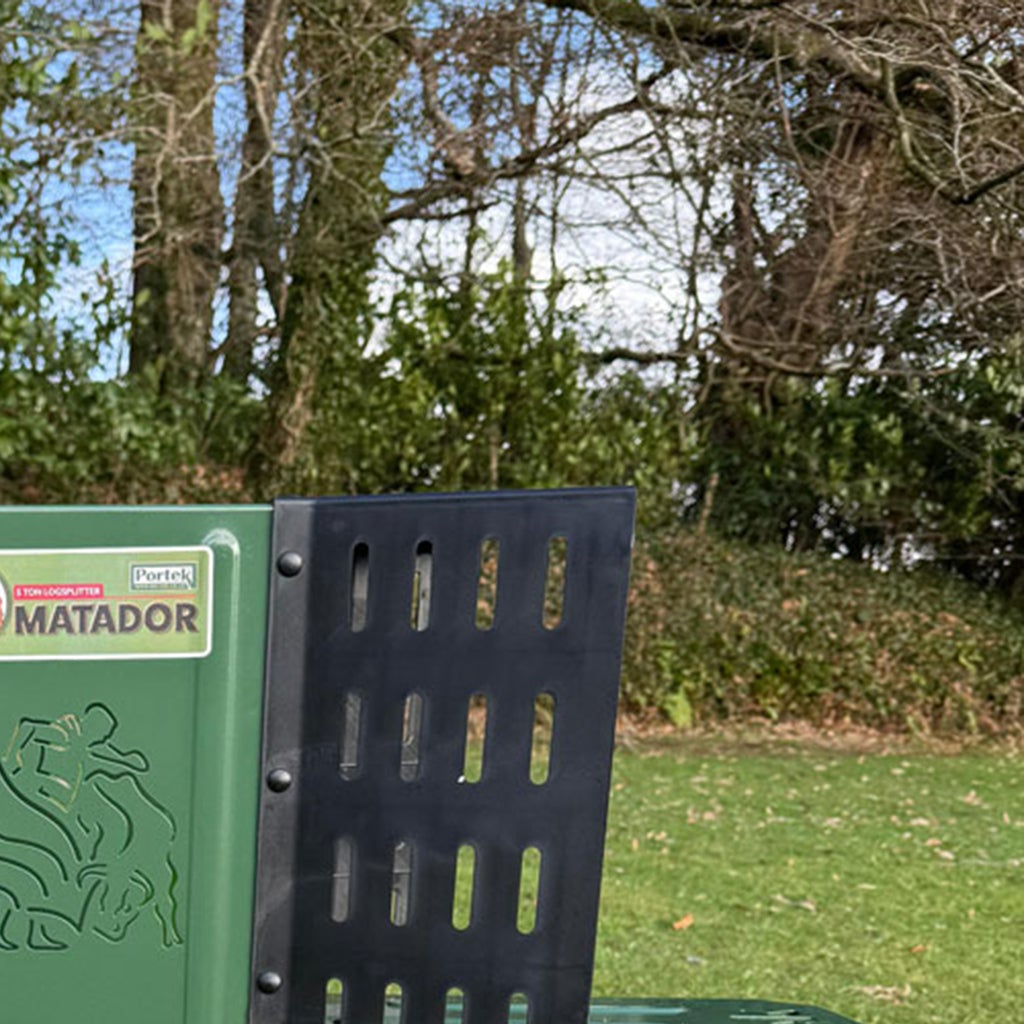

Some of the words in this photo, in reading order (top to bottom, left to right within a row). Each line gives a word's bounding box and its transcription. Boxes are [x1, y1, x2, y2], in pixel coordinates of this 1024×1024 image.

[136, 567, 193, 586] Portek
[24, 588, 42, 597] TON
[43, 587, 100, 597] LOGSPLITTER
[14, 603, 198, 635] MATADOR
